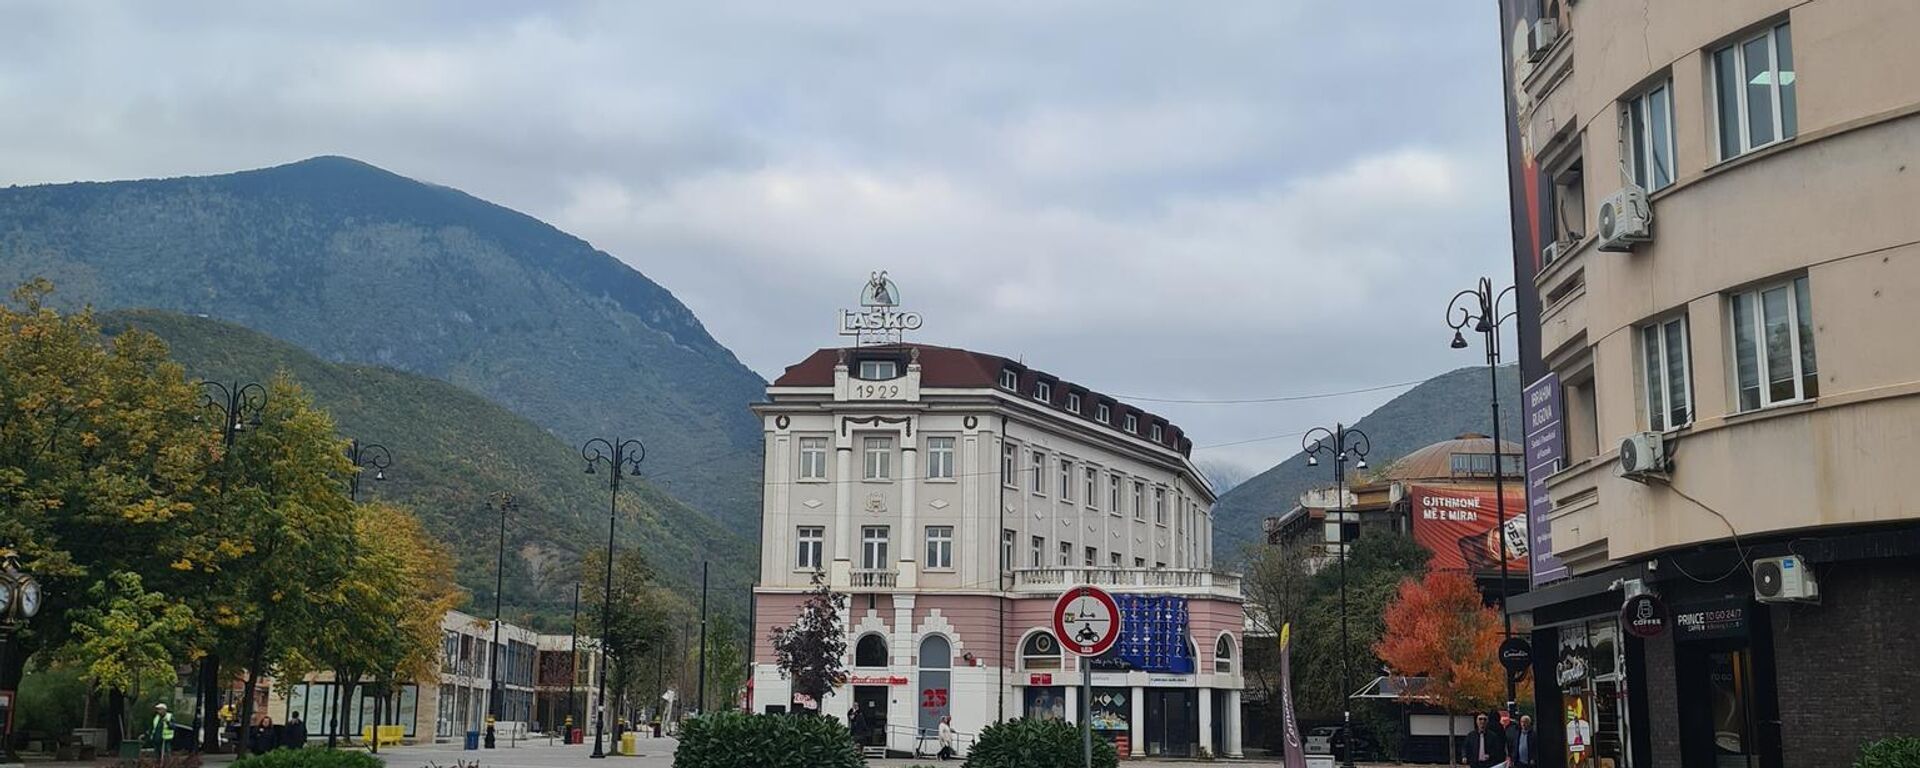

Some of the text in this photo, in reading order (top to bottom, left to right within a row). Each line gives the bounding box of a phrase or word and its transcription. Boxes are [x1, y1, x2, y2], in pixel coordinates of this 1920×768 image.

[840, 309, 922, 335] LAŠKO
[857, 385, 898, 399] 1929
[1423, 496, 1481, 508] GJITHMONË
[1423, 507, 1438, 520] MË
[1440, 510, 1446, 520] E
[1504, 520, 1528, 556] PEJA
[1677, 612, 1705, 626] PRINCE
[1706, 611, 1714, 620] TO
[1715, 610, 1725, 619] GO
[1726, 608, 1742, 618] 24/7
[922, 688, 948, 708] 25
